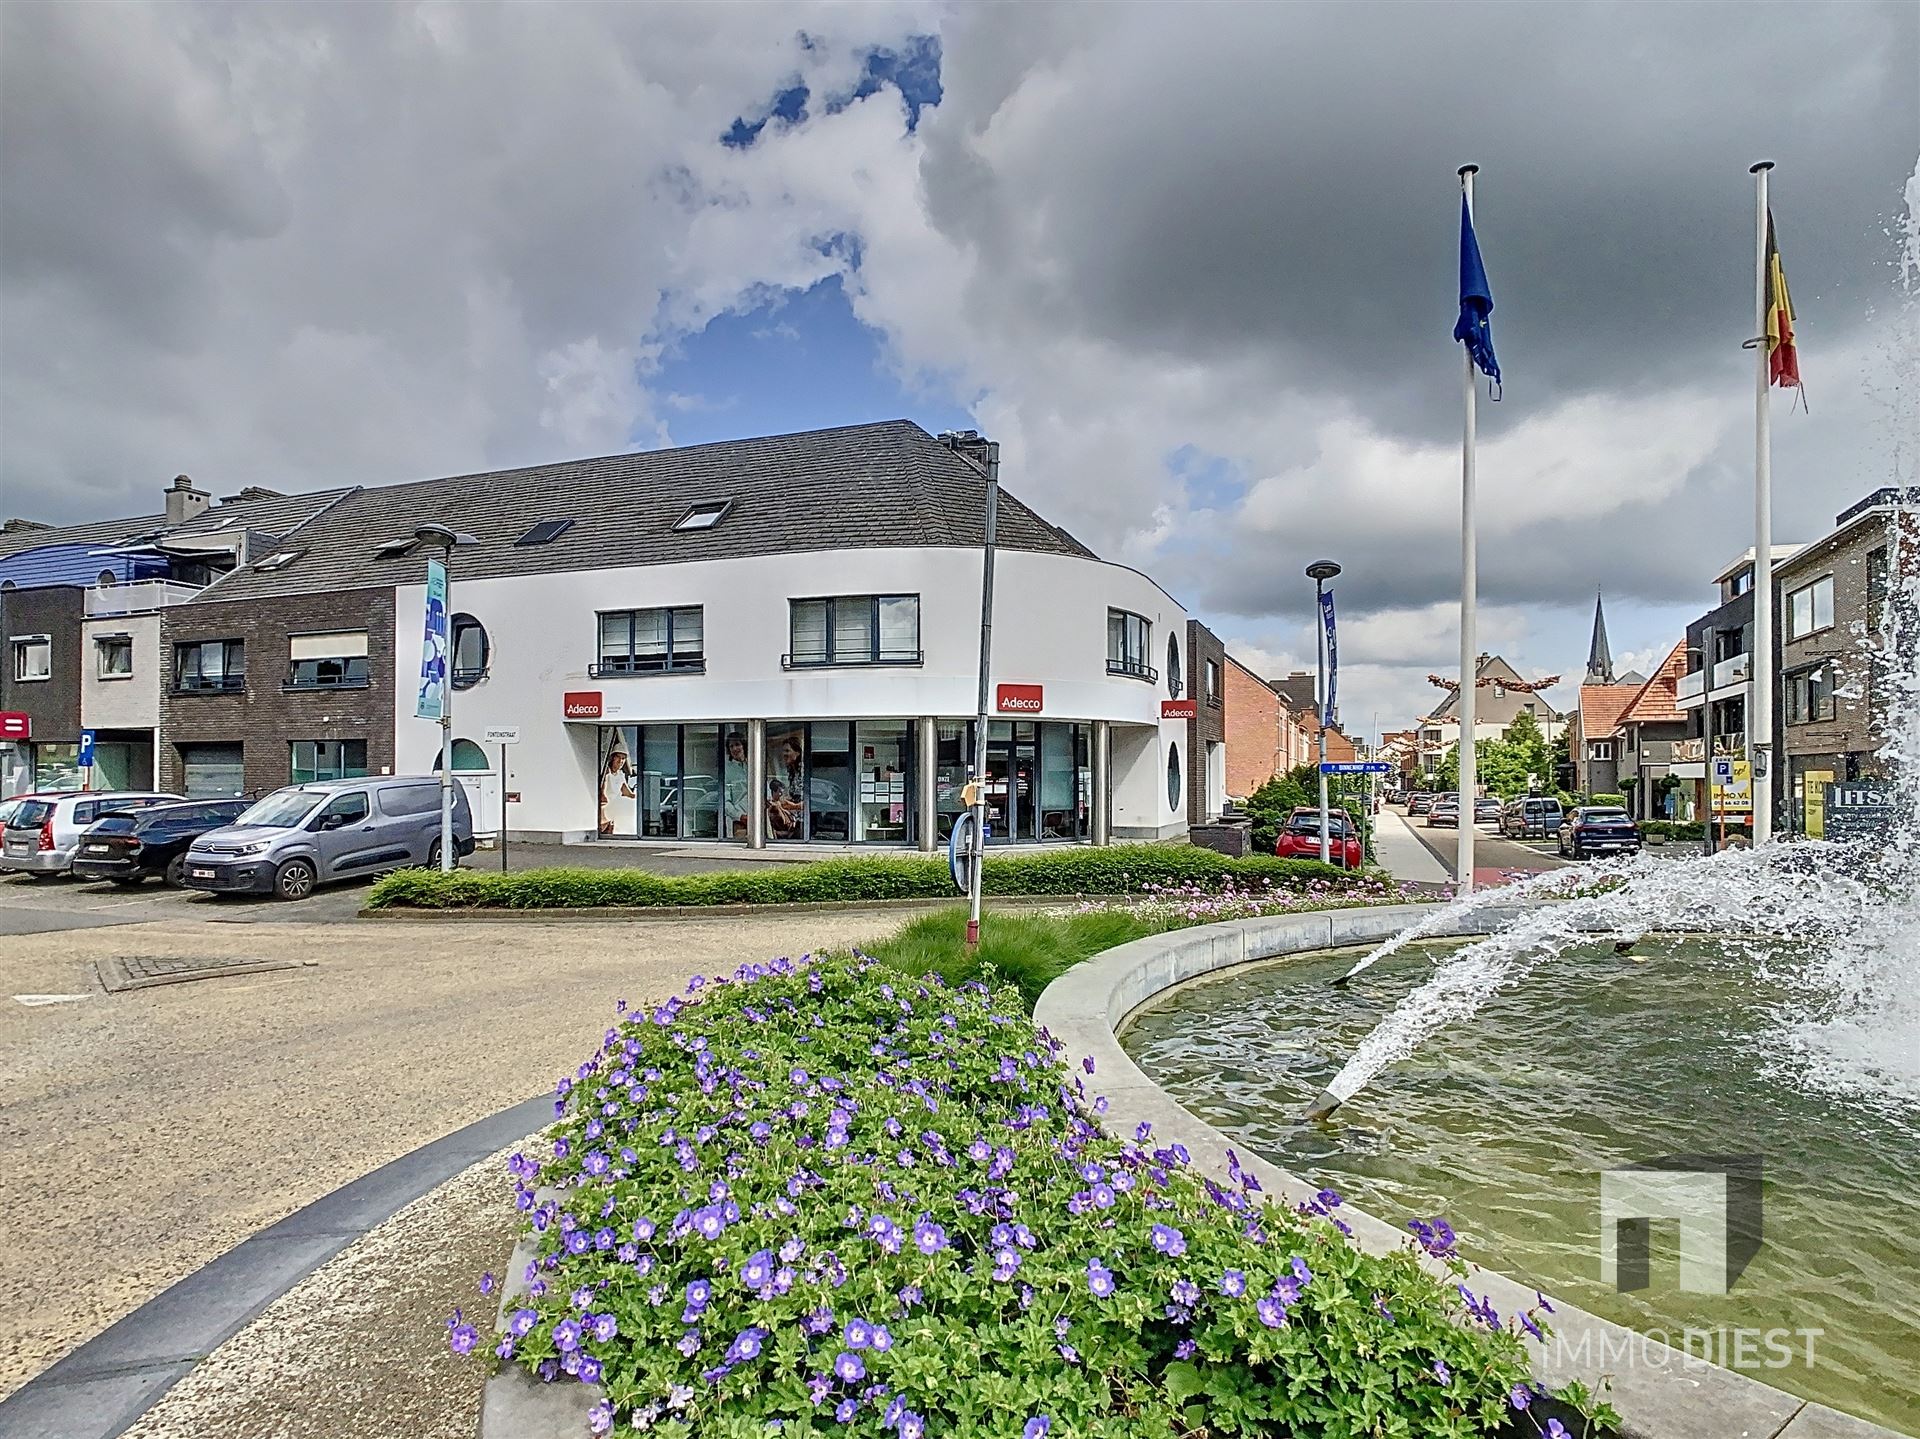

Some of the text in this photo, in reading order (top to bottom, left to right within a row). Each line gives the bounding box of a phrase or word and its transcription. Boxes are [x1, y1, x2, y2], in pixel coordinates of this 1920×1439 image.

[1001, 696, 1040, 709] Adecco
[567, 704, 599, 714] Adecco
[1163, 708, 1194, 717] Adecco
[81, 734, 92, 753] P
[1719, 764, 1727, 773] P
